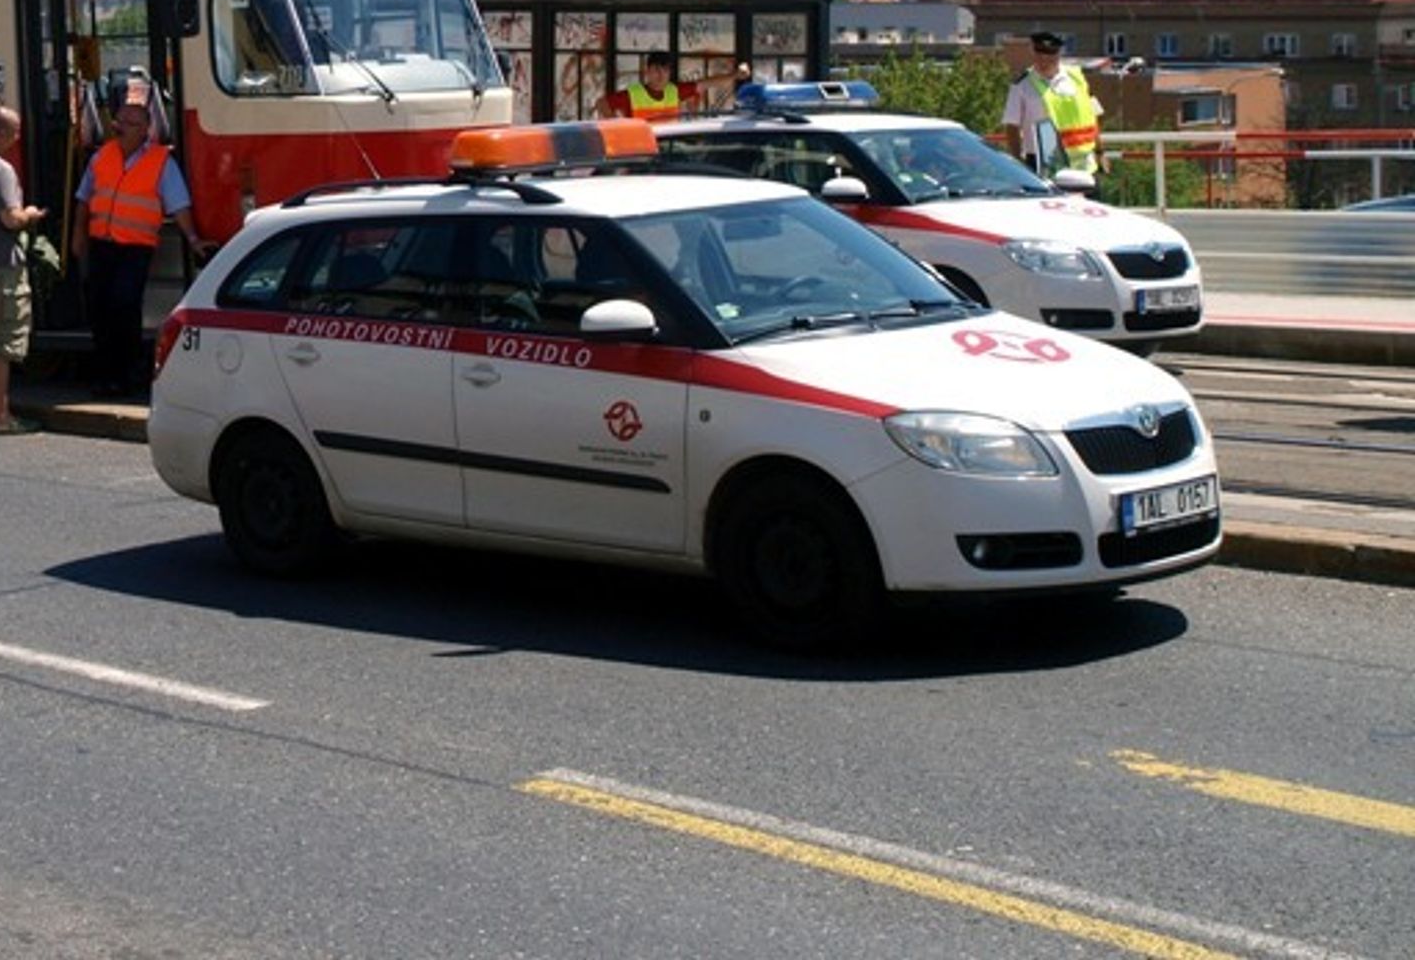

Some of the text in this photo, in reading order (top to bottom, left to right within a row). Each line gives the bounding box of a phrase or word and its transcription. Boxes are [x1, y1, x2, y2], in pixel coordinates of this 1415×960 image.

[182, 326, 201, 351] 31
[285, 317, 593, 368] POHOTOVOSTNÍ VOZIDLO
[1138, 481, 1209, 522] 1AL 0157
